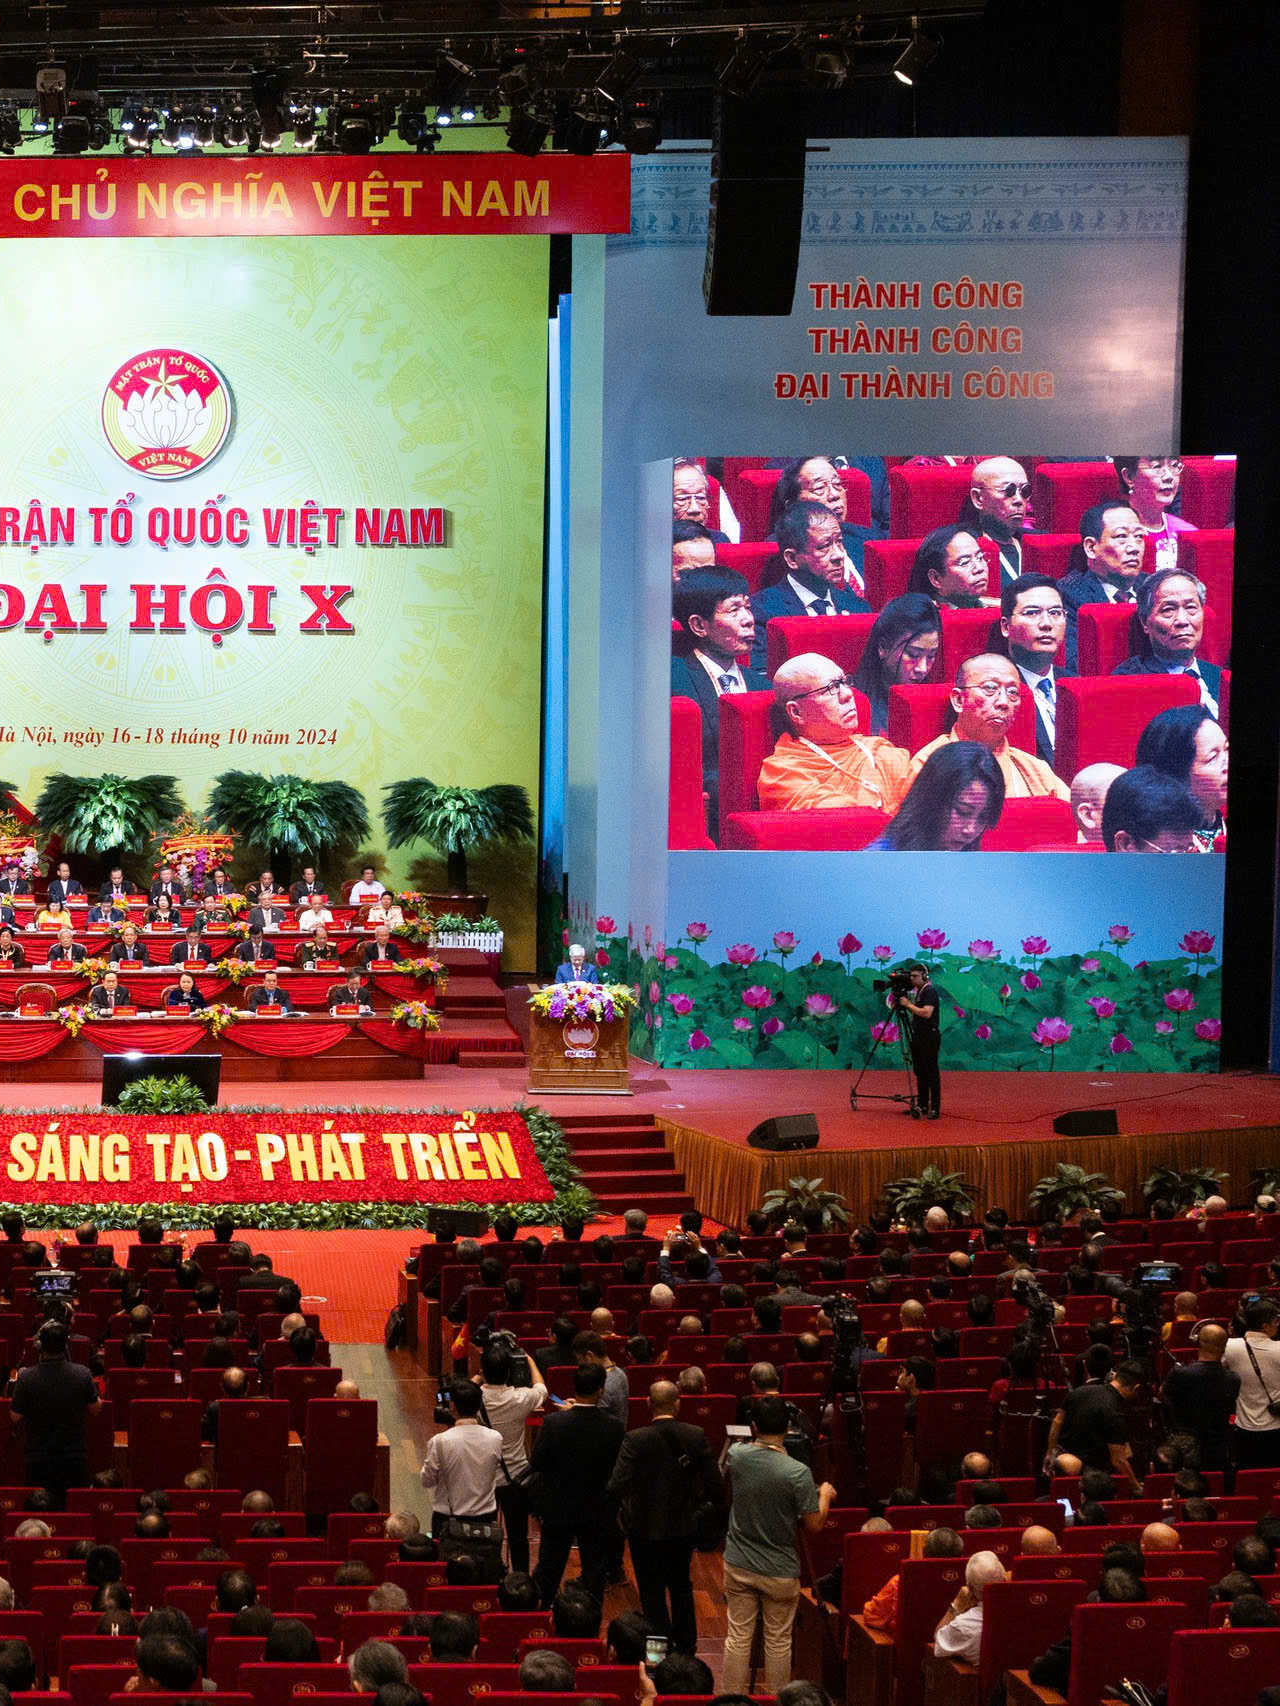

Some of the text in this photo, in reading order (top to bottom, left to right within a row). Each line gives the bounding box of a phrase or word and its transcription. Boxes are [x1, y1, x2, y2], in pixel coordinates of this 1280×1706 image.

[13, 168, 117, 221] CHỦ
[137, 172, 296, 221] NGHĨA
[312, 170, 423, 226] VIỆT
[442, 180, 550, 217] NAM
[809, 276, 1024, 310] THÀNH CÔNG
[808, 322, 1023, 355] THÀNH CÔNG
[774, 366, 1055, 406] ĐẠI THÀNH CÔNG
[138, 453, 192, 467] VIỆT NAM
[88, 492, 136, 545] TỔ
[147, 492, 250, 548] QUỐC
[263, 499, 342, 553] VIỆT
[354, 507, 445, 545] NAM
[129, 566, 276, 646] HỘI
[299, 584, 355, 630] X
[22, 726, 57, 747] Nội,
[63, 727, 105, 748] ngày
[170, 728, 221, 749] tháng
[228, 728, 247, 744] 10
[252, 730, 290, 744] năm
[296, 728, 338, 744] 2024
[6, 1121, 131, 1183] SÁNG
[145, 1132, 229, 1193] TẠO
[255, 1119, 367, 1182] PHÁT
[381, 1110, 522, 1181] TRIỂN
